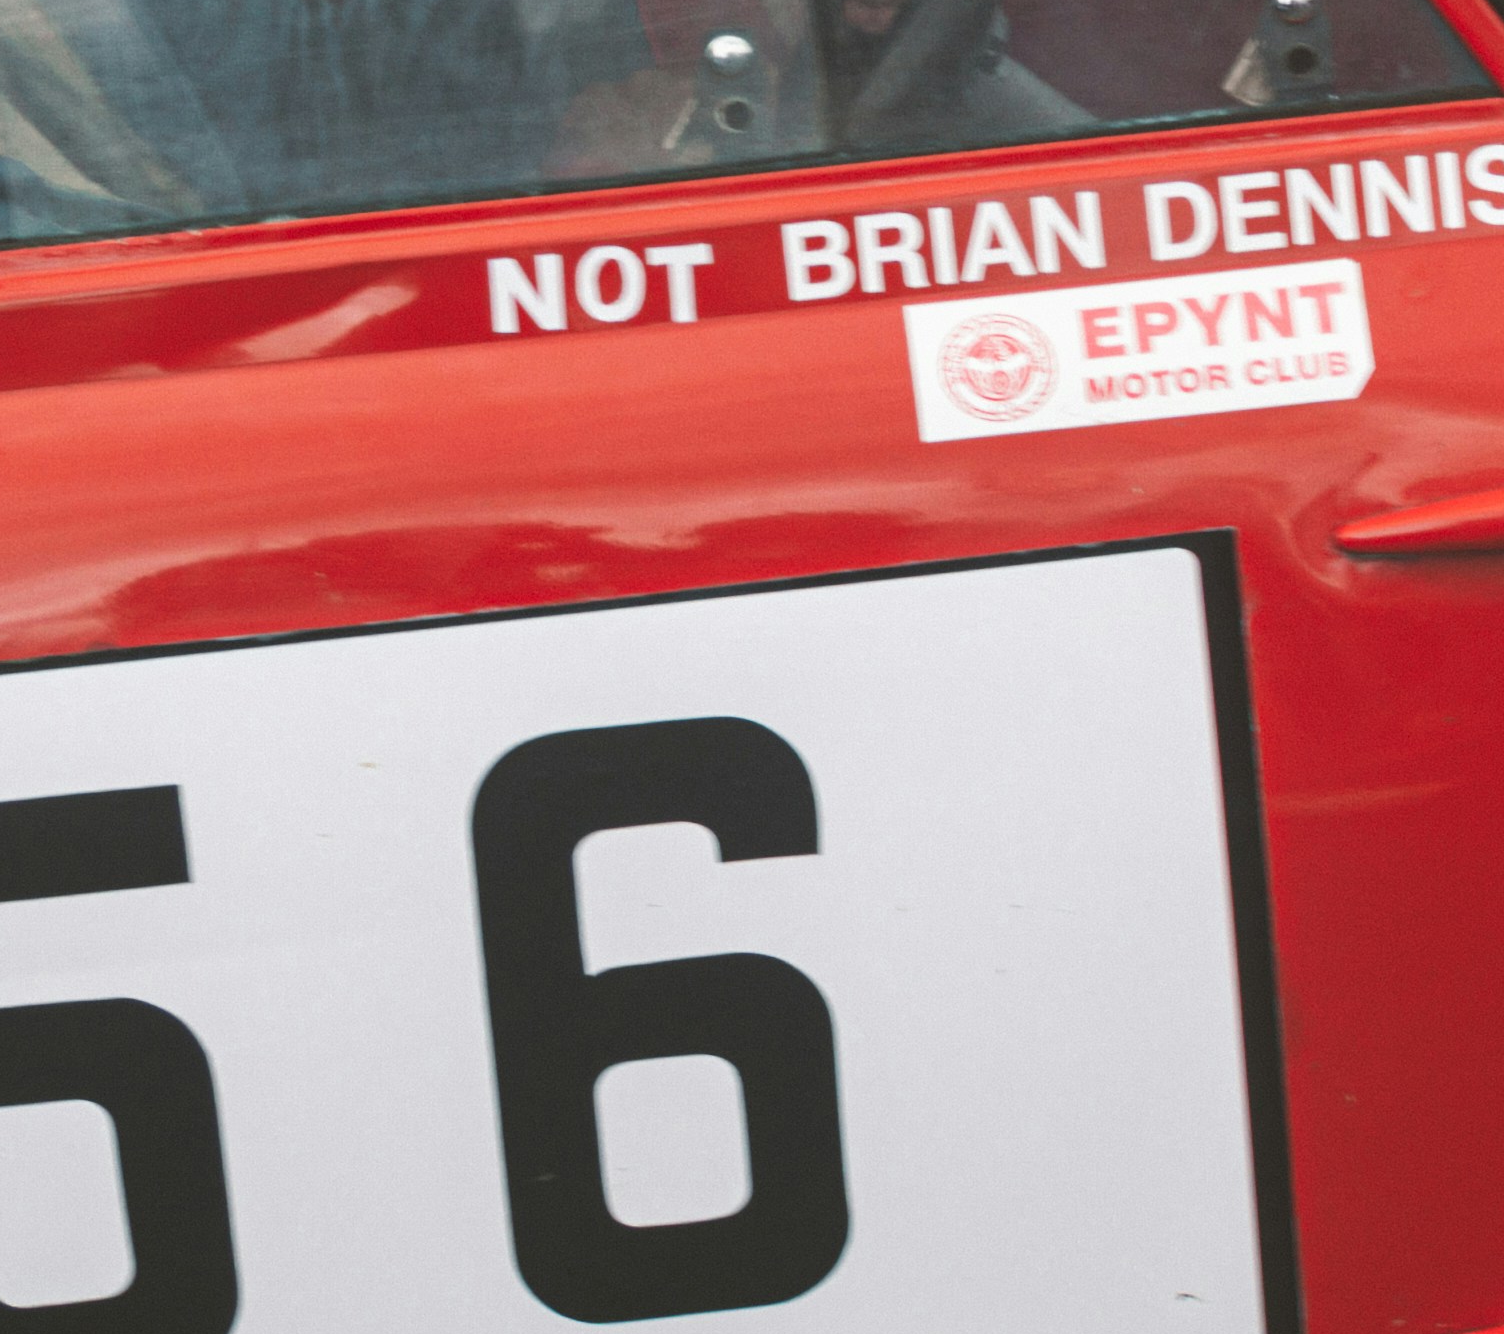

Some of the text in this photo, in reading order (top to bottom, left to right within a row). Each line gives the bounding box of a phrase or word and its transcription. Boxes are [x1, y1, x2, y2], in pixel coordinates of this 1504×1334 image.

[487, 240, 713, 335] NOT
[781, 189, 1101, 302] BRIAN
[1079, 280, 1345, 361] EPYNT
[1084, 351, 1351, 405] MOTOR CLUB
